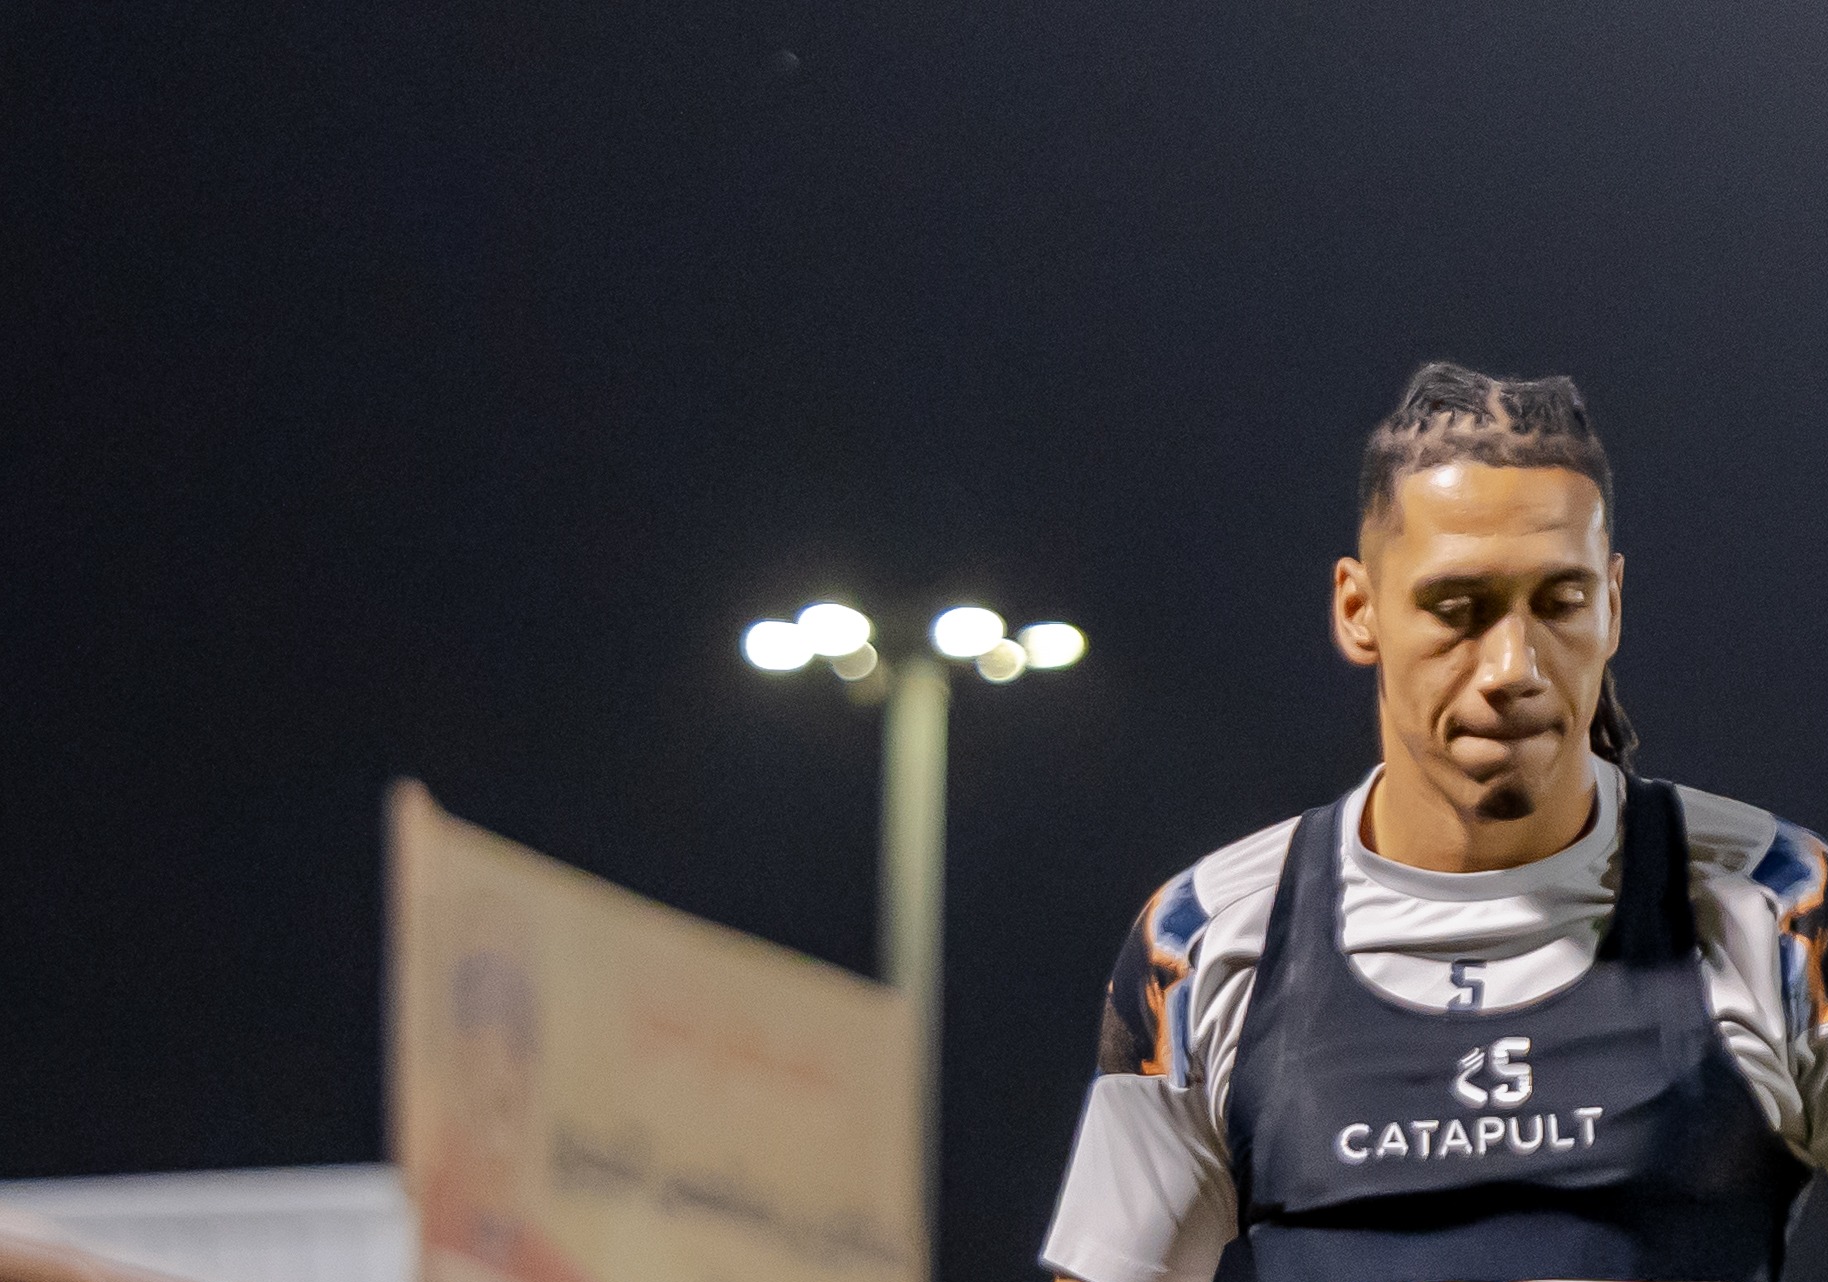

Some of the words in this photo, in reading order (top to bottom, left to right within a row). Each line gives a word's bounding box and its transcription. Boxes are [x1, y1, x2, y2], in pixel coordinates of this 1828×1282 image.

[1447, 957, 1487, 1011] 5
[1490, 1036, 1532, 1107] 5
[1334, 1106, 1603, 1165] CATAPULT
